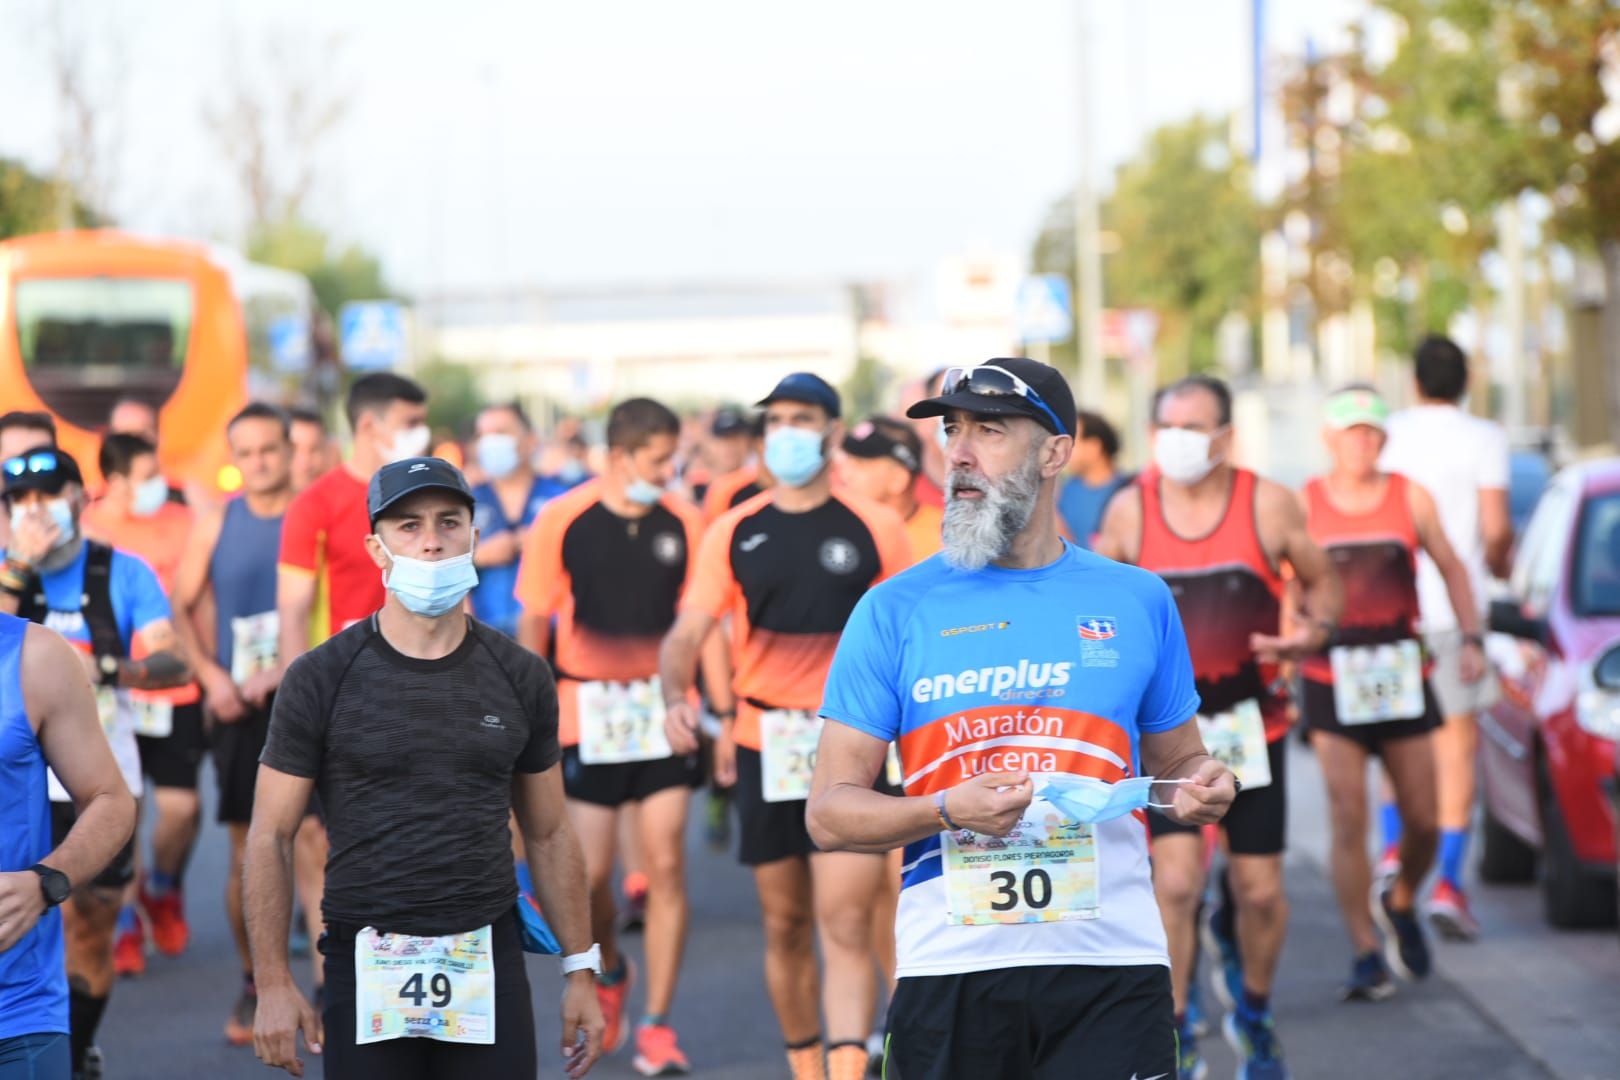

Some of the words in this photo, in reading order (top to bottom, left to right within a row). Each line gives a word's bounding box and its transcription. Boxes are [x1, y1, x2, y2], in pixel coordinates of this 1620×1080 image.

[912, 659, 1071, 703] enerplus
[944, 709, 1064, 746] Maratón
[959, 750, 1057, 779] Lucena
[994, 852, 1022, 862] FLORES
[990, 868, 1052, 911] 30
[398, 973, 452, 1008] 49
